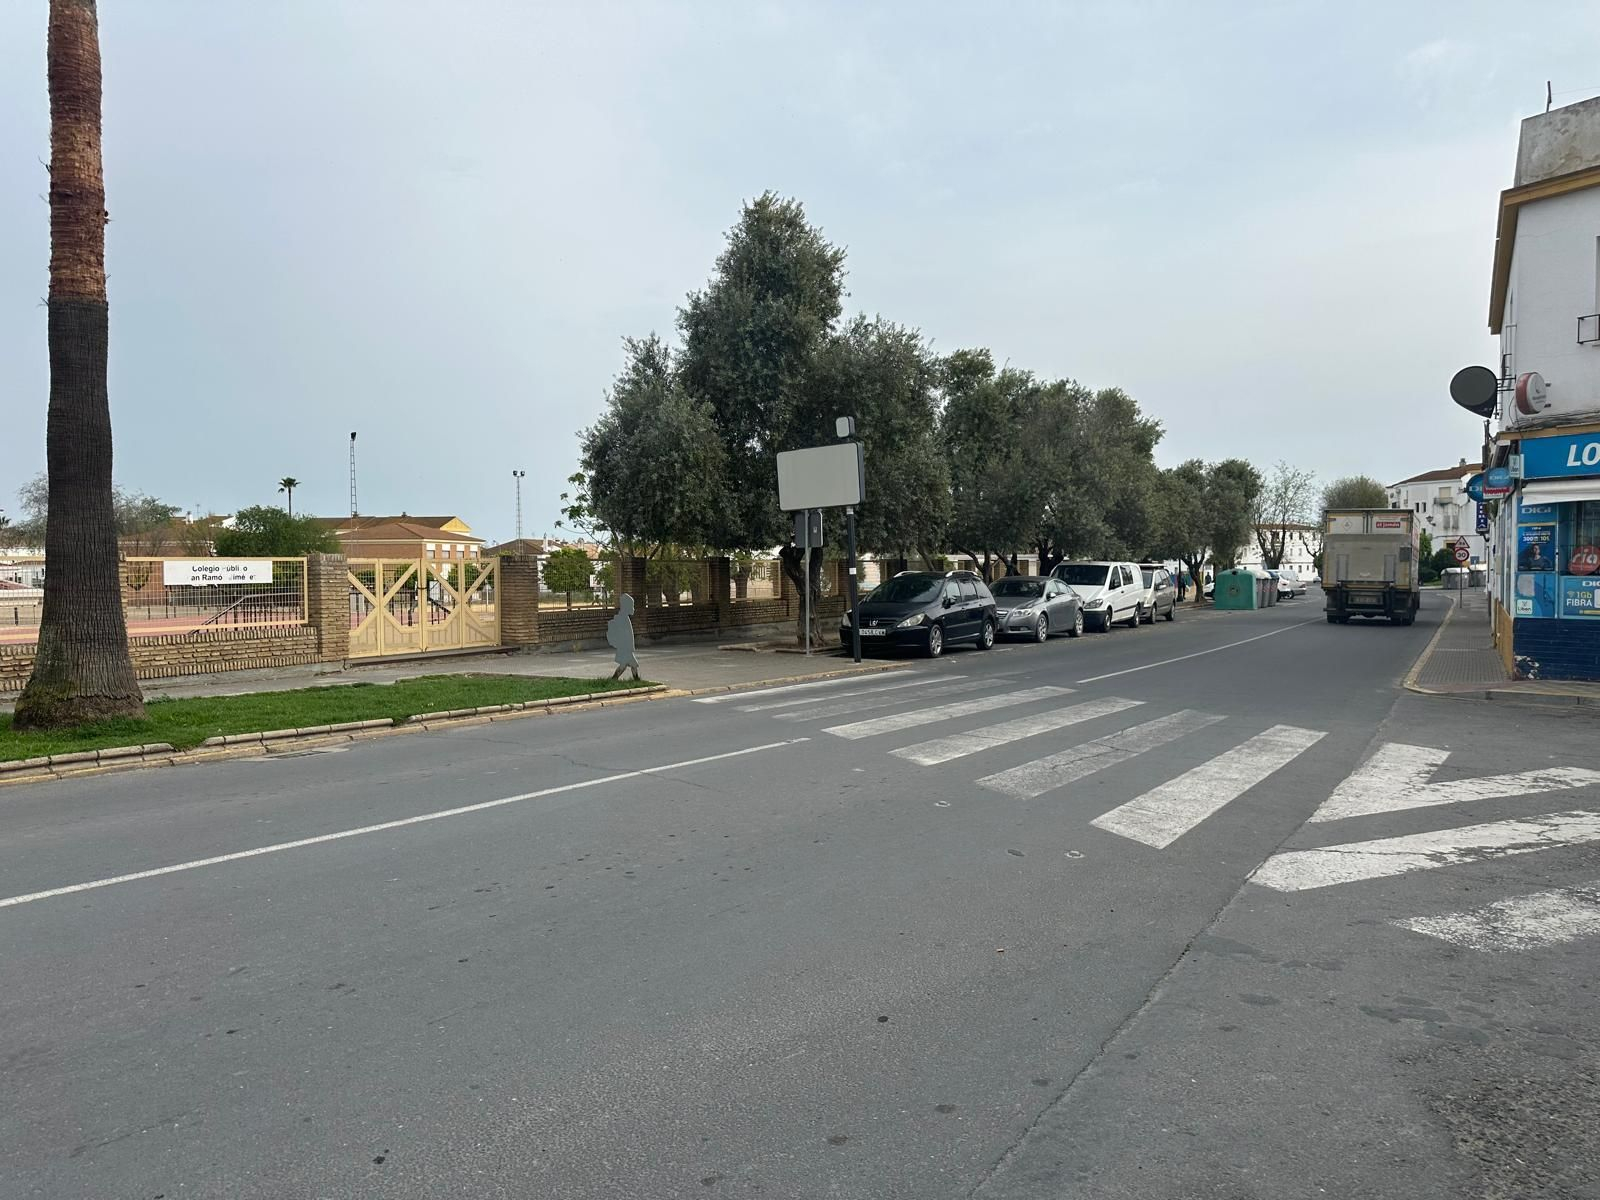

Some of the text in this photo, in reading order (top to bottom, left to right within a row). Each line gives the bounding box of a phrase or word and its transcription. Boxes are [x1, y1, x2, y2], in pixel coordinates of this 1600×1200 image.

[1572, 548, 1598, 565] ria
[192, 565, 220, 573] Colegio
[1577, 591, 1592, 599] 1Gb
[1566, 598, 1592, 607] FIBRA
